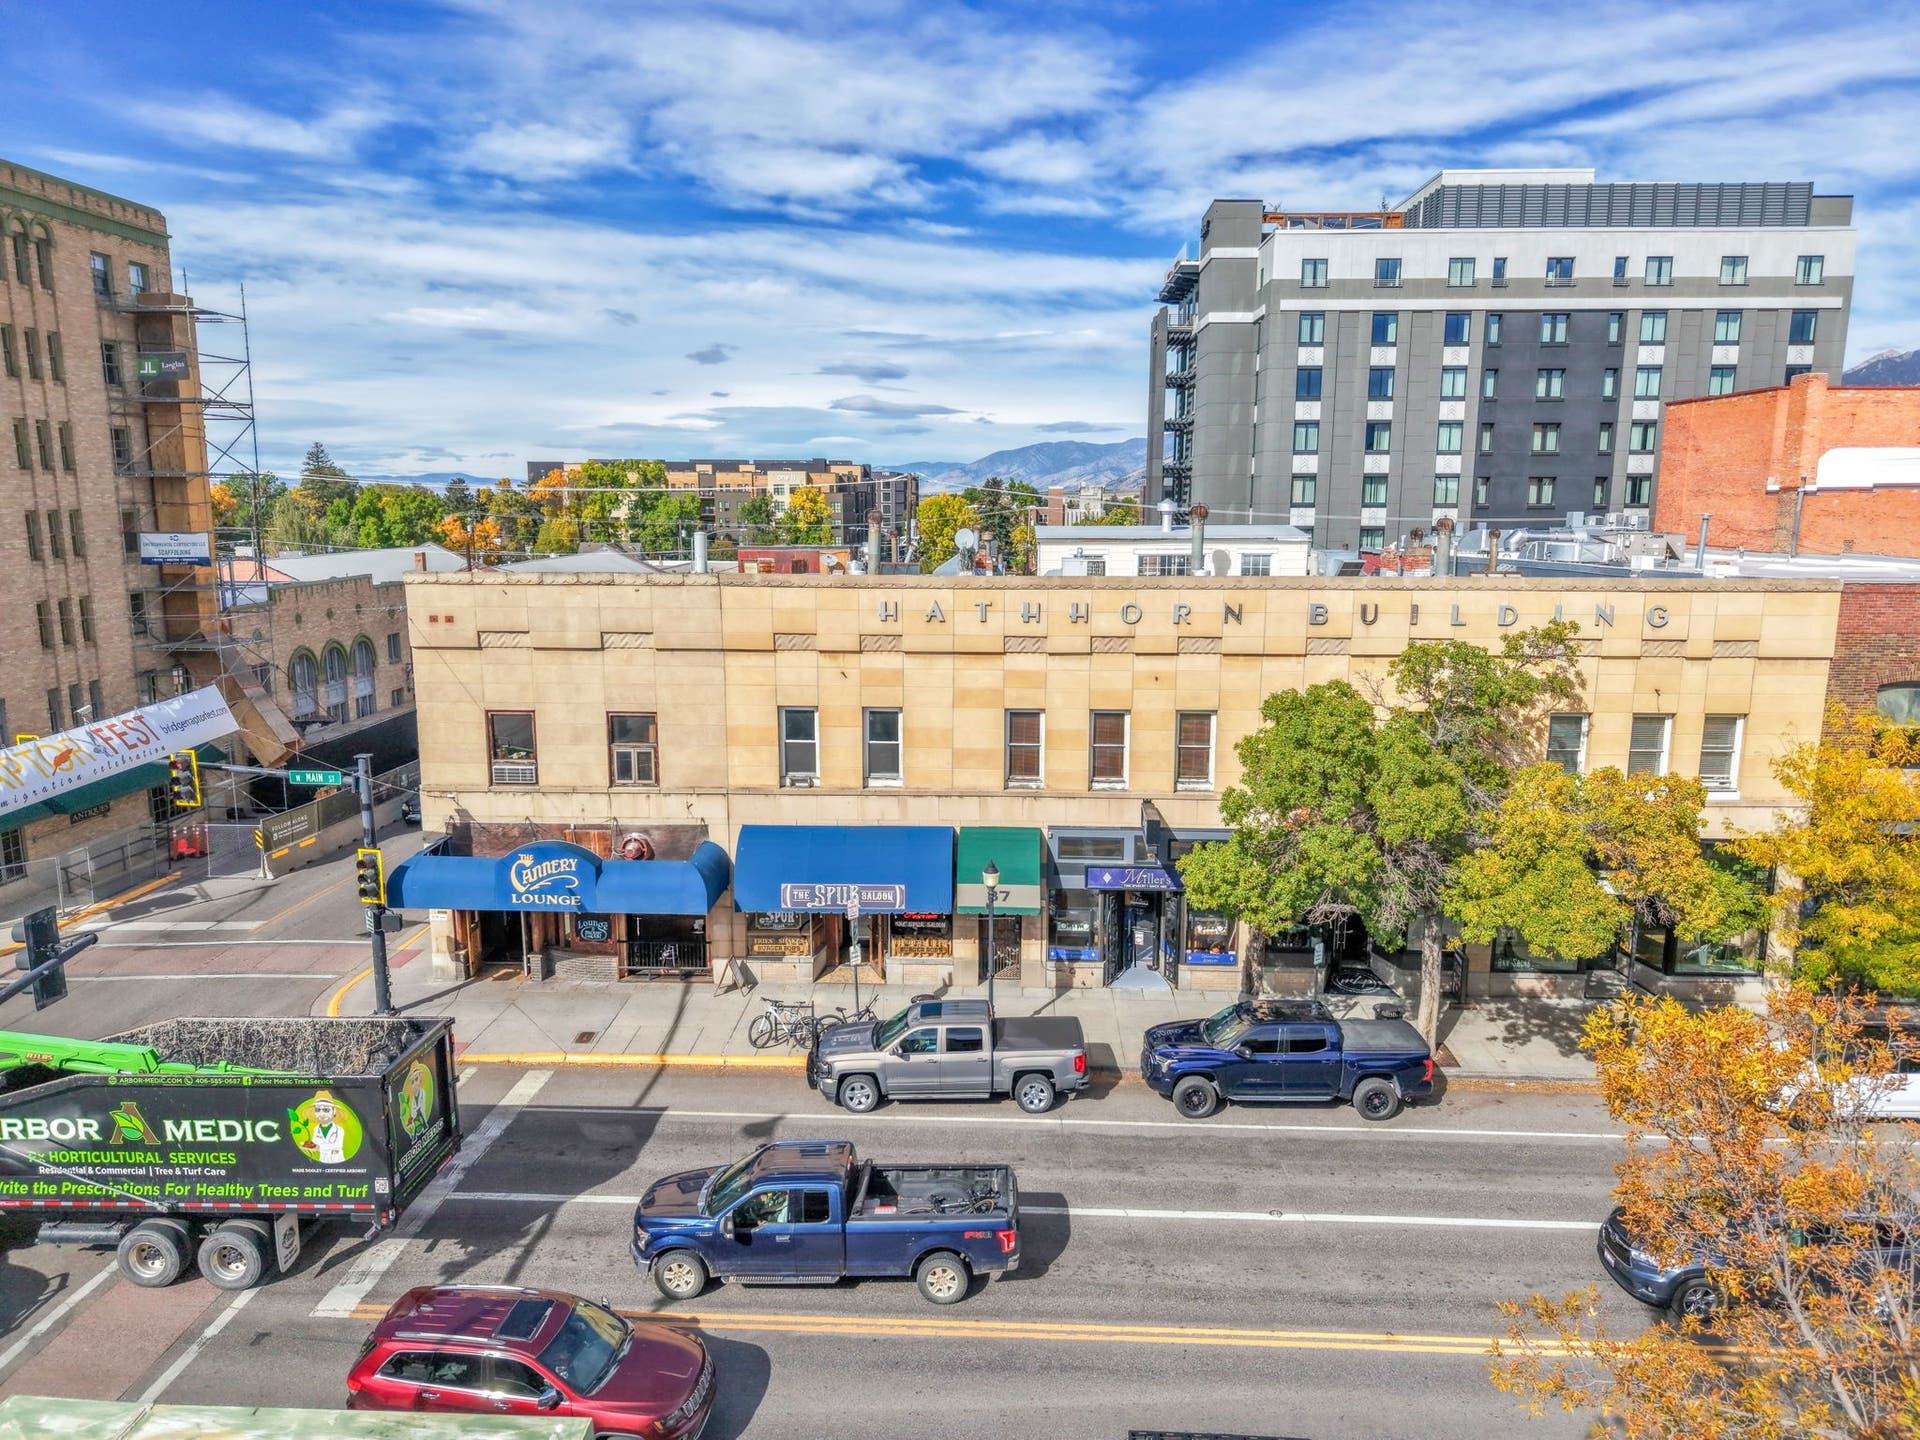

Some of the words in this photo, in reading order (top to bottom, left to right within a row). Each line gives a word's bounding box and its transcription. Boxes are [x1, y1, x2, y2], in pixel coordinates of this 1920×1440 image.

[878, 599, 1245, 625] HATHHORN
[1308, 602, 1671, 629] BUILDING
[159, 705, 229, 735] bridgerraptorfest.com
[91, 714, 161, 755] FEST
[0, 774, 82, 807] migration
[93, 745, 166, 775] celebration
[295, 774, 301, 782] W
[305, 772, 323, 783] MAIN
[328, 775, 335, 783] ST
[510, 858, 578, 893] CANNERY
[1120, 868, 1172, 885] Miller's
[511, 893, 582, 906] LOUNGE
[793, 891, 810, 900] THE
[861, 890, 893, 901] SALOON
[0, 1118, 103, 1141] RBOR
[163, 1119, 282, 1143] MEDIC
[50, 1151, 163, 1164] HORTICULTURAL
[169, 1152, 237, 1164] SERVICES
[39, 1166, 87, 1175] Residential
[88, 1167, 94, 1175] &
[95, 1167, 146, 1175] Commercial
[155, 1167, 173, 1175] Tree
[175, 1167, 181, 1175] &
[184, 1167, 202, 1175] Turf
[204, 1168, 226, 1176] Care
[0, 1181, 29, 1195] rite
[33, 1182, 57, 1195] the
[61, 1182, 160, 1197] Prescriptions
[165, 1183, 191, 1196] For
[196, 1183, 254, 1199] Healthy
[258, 1184, 299, 1197] Trees
[303, 1184, 333, 1198] and
[337, 1185, 369, 1198] Turf
